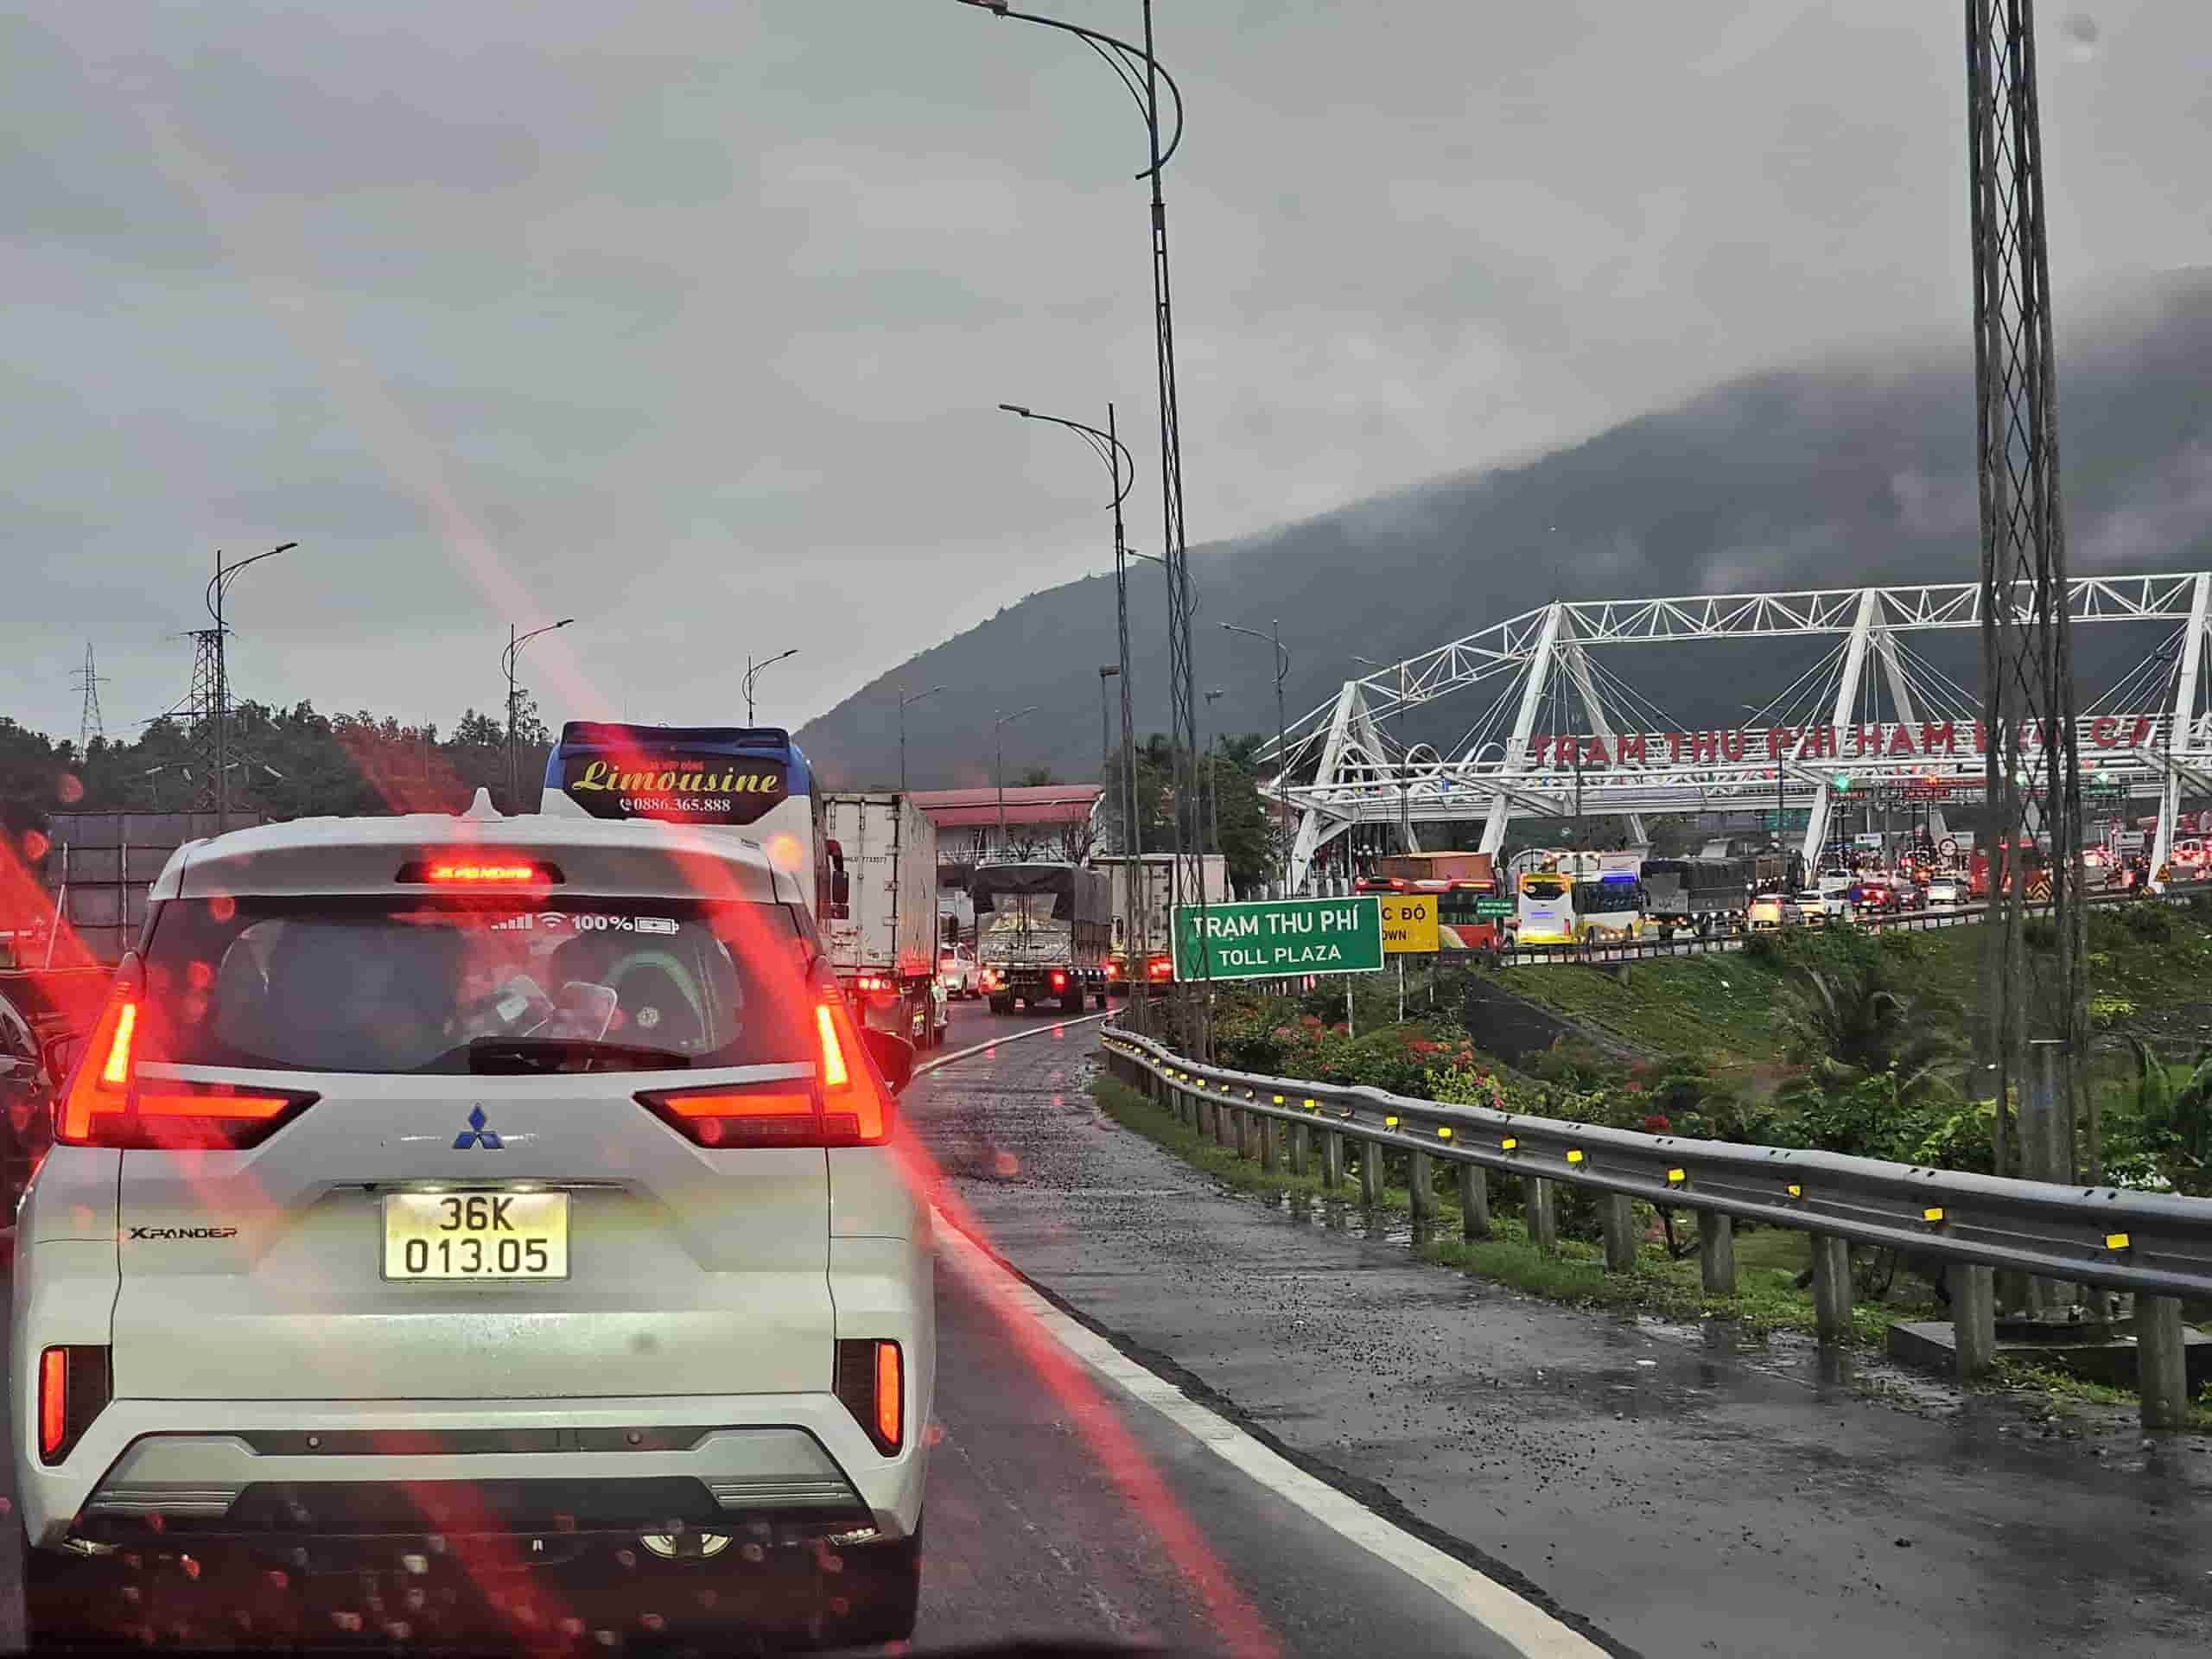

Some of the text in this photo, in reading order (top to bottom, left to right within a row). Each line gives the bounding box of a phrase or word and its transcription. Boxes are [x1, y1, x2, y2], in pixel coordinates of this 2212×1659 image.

[572, 760, 779, 792] Limousine
[572, 915, 634, 931] 100%
[1190, 914, 1259, 941] TRẠM
[1265, 912, 1313, 934] THU
[1320, 904, 1360, 932] PHÍ
[1402, 903, 1426, 924] ĐỘ
[1382, 929, 1407, 940] OWN
[1217, 944, 1342, 967] TOLL PLAZA
[439, 1196, 515, 1231] 36K
[130, 1226, 238, 1239] XPANDER
[405, 1237, 548, 1274] 013.05
